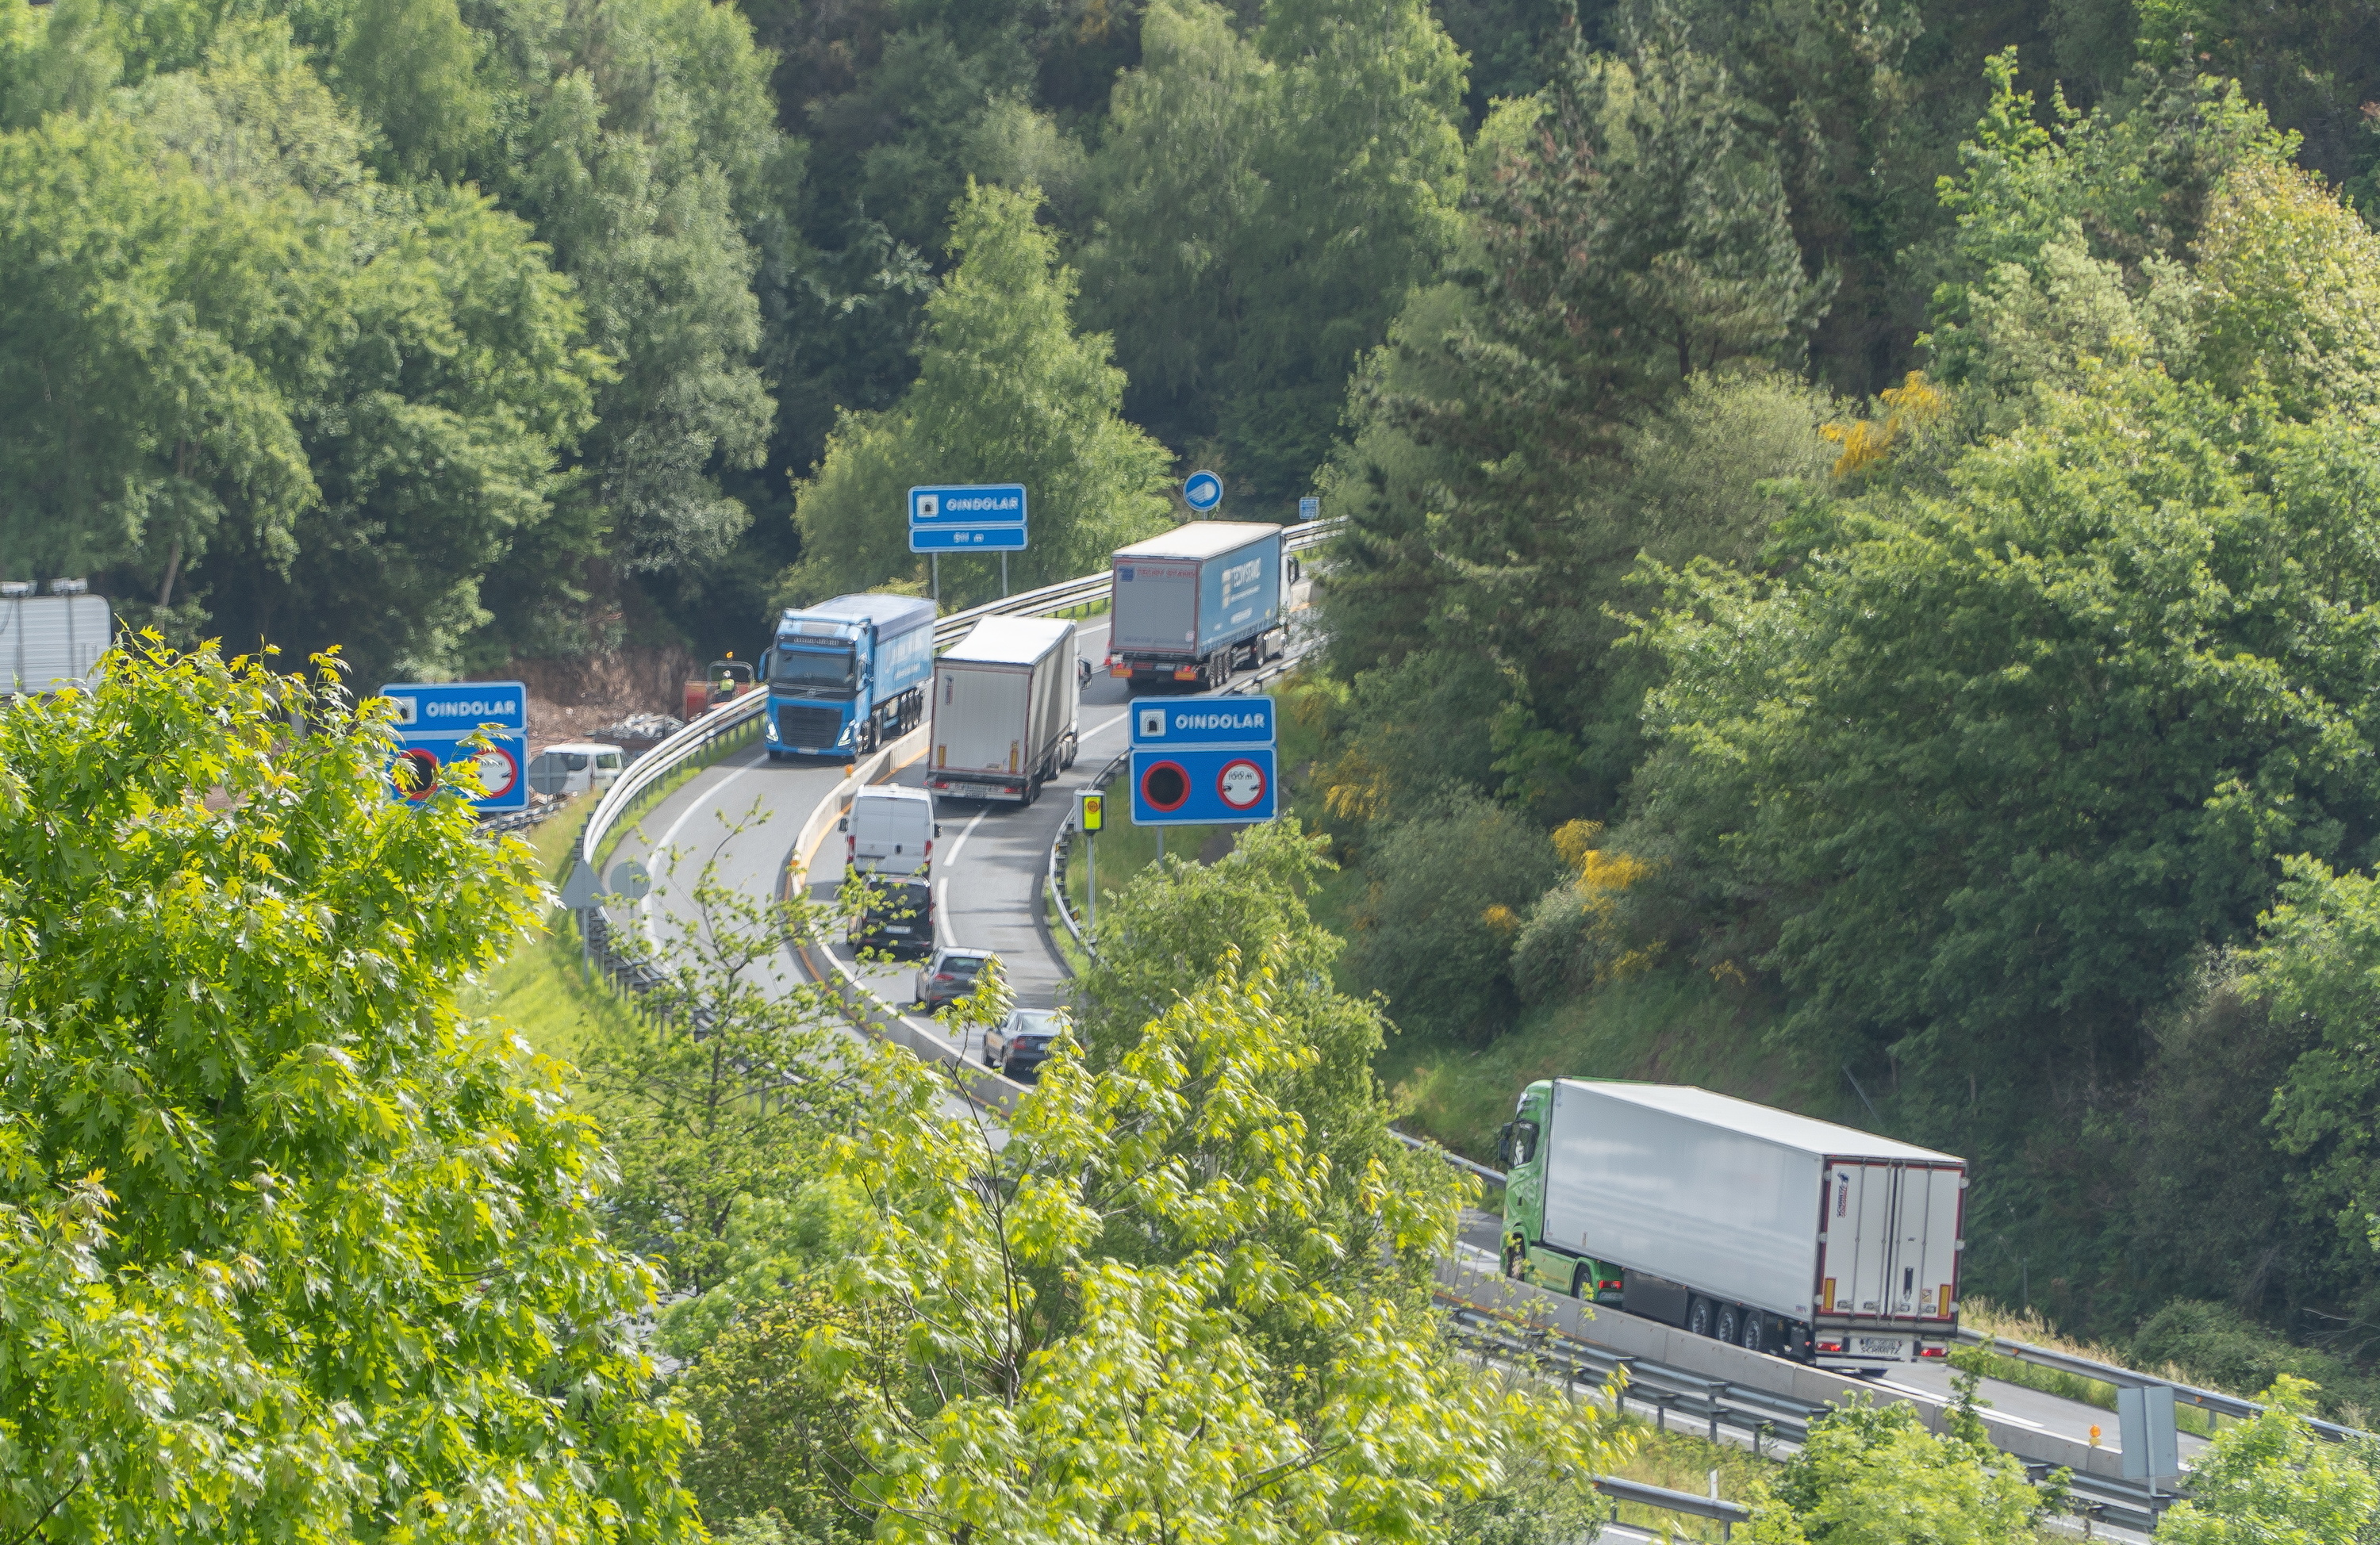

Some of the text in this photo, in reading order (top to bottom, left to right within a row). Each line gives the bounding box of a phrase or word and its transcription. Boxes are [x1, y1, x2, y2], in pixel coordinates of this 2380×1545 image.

[946, 497, 1019, 511] OINDOLAR
[426, 700, 516, 718] OINDOLAR
[1176, 713, 1265, 730] OINDOLAR
